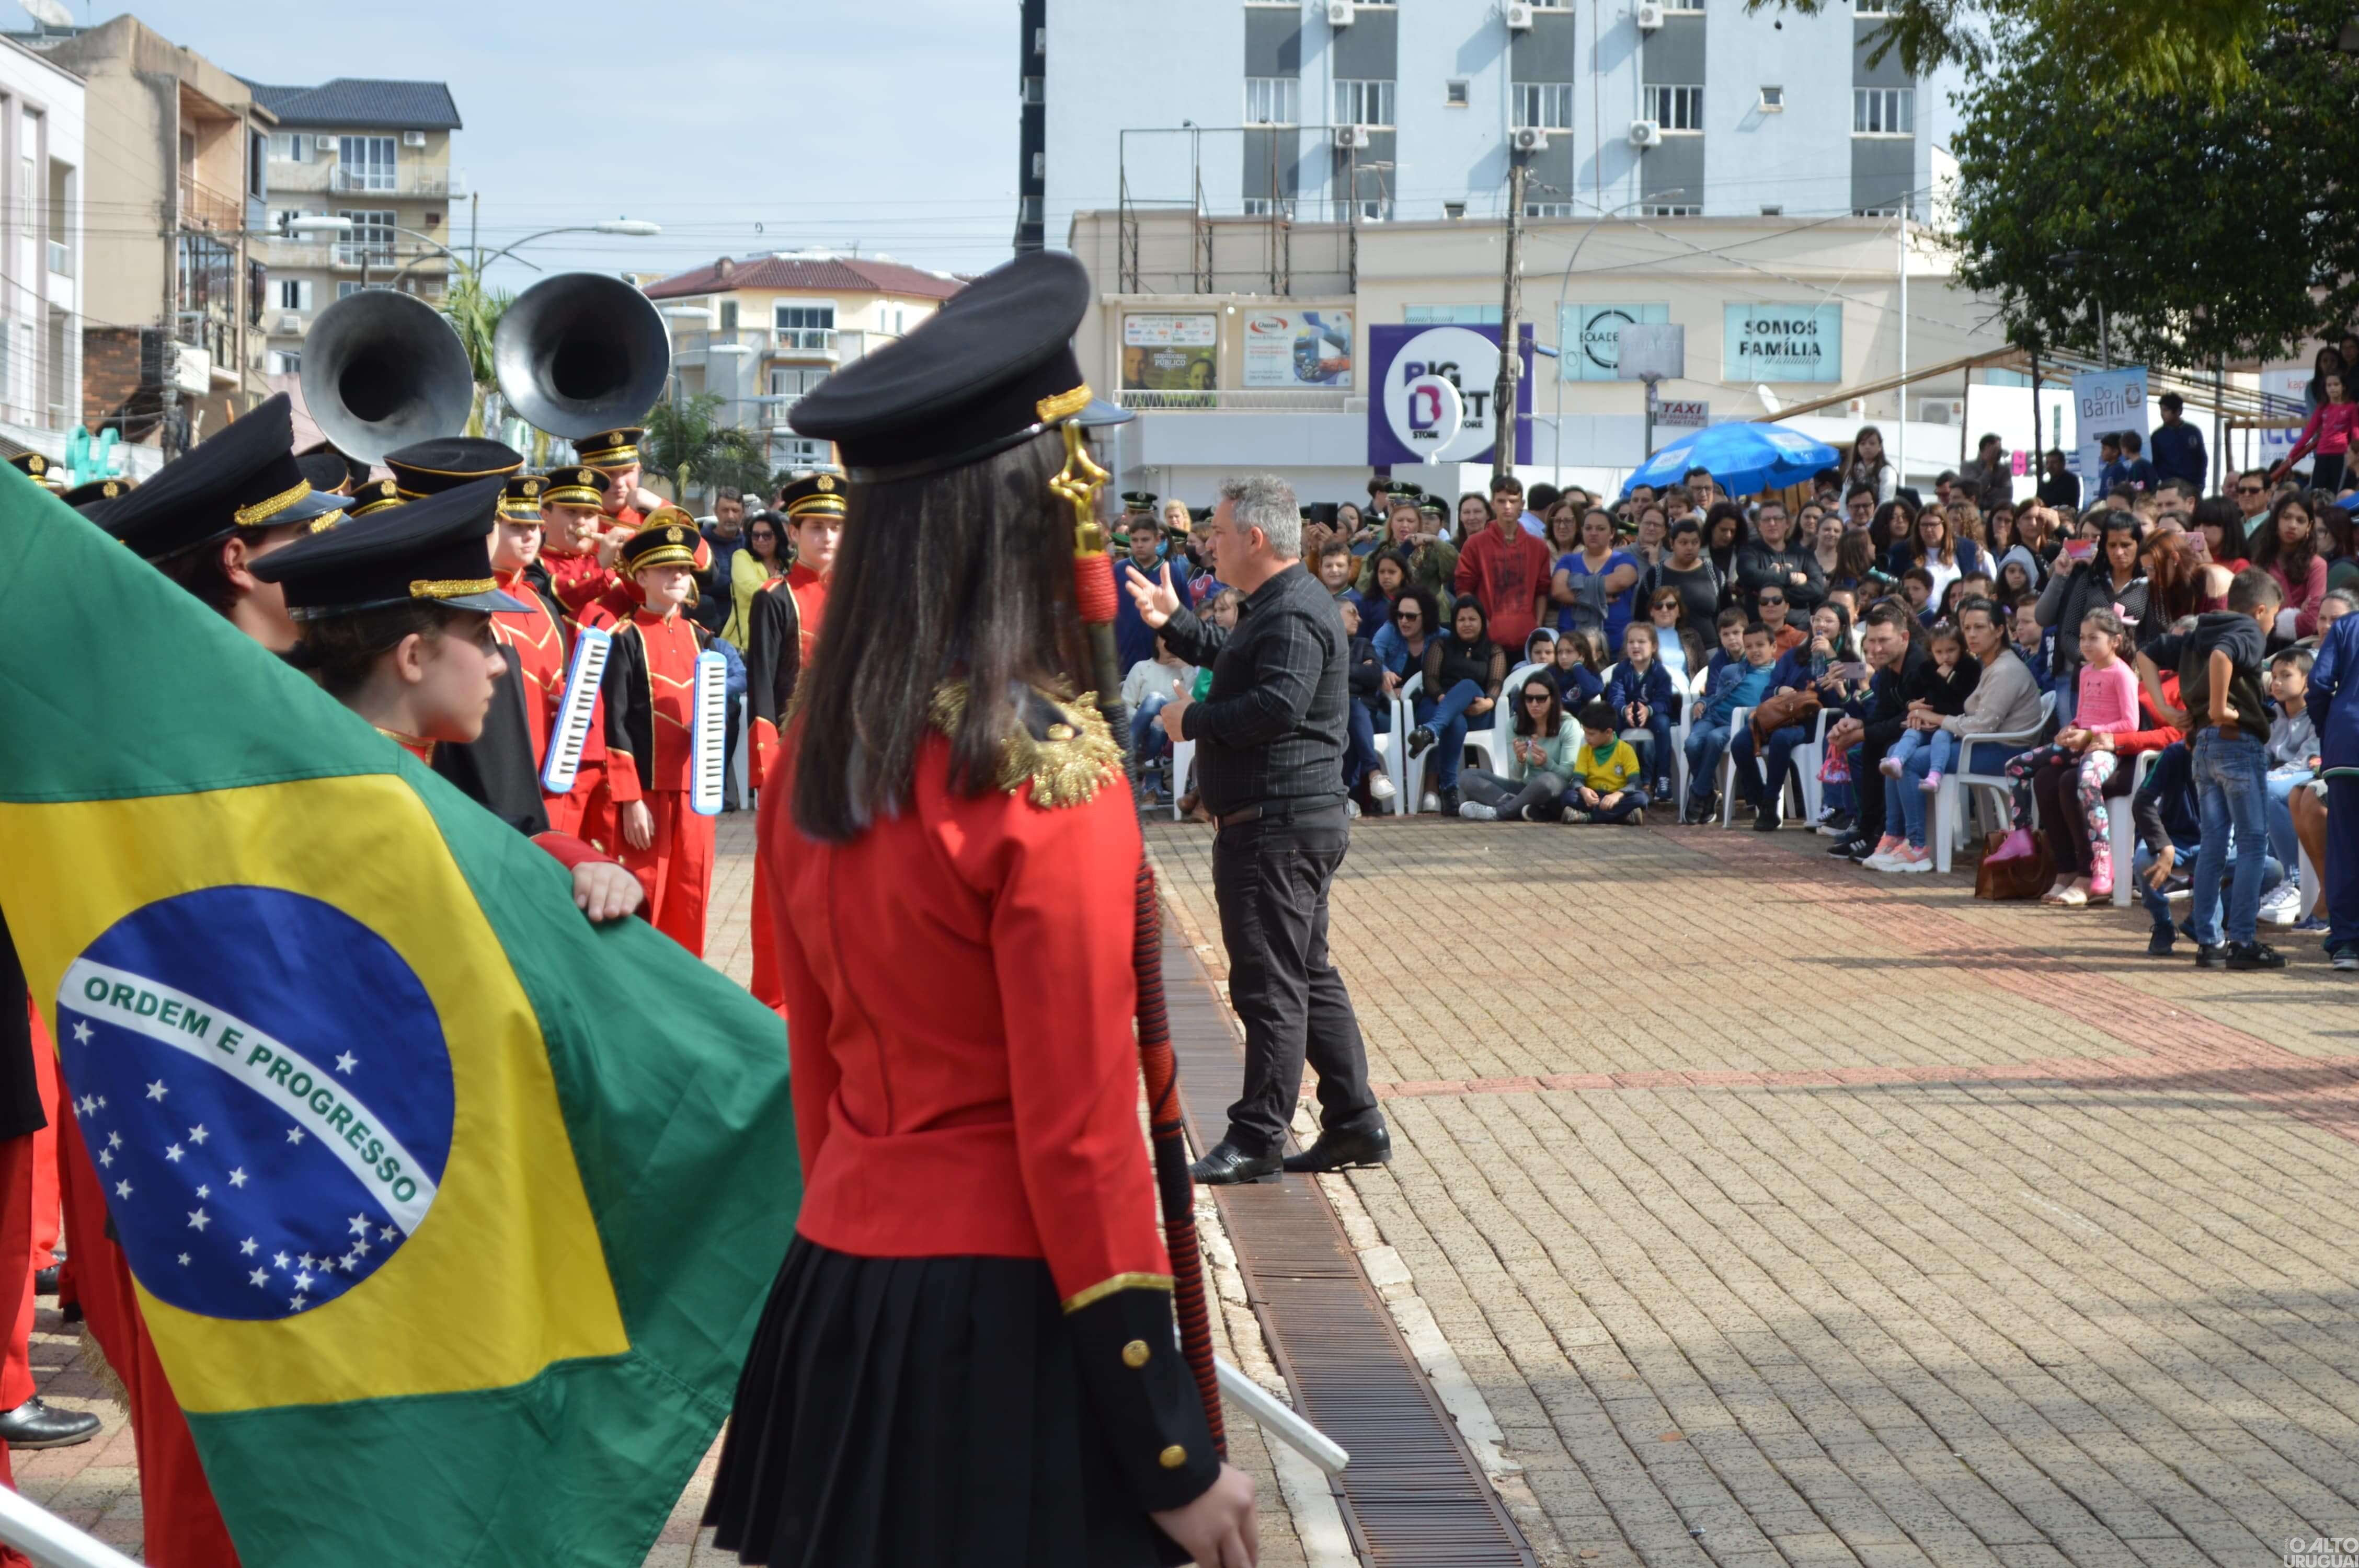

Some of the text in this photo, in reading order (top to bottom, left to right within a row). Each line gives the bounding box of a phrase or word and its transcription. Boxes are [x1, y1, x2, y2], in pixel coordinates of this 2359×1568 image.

[1745, 320, 1817, 335] SOMOS
[1739, 337, 1822, 356] FAMÍLIA
[2095, 386, 2112, 401] Do
[2082, 395, 2125, 418] Barril
[1413, 430, 1439, 439] STORE
[84, 976, 417, 1203] ORDEM E PROGRESSO
